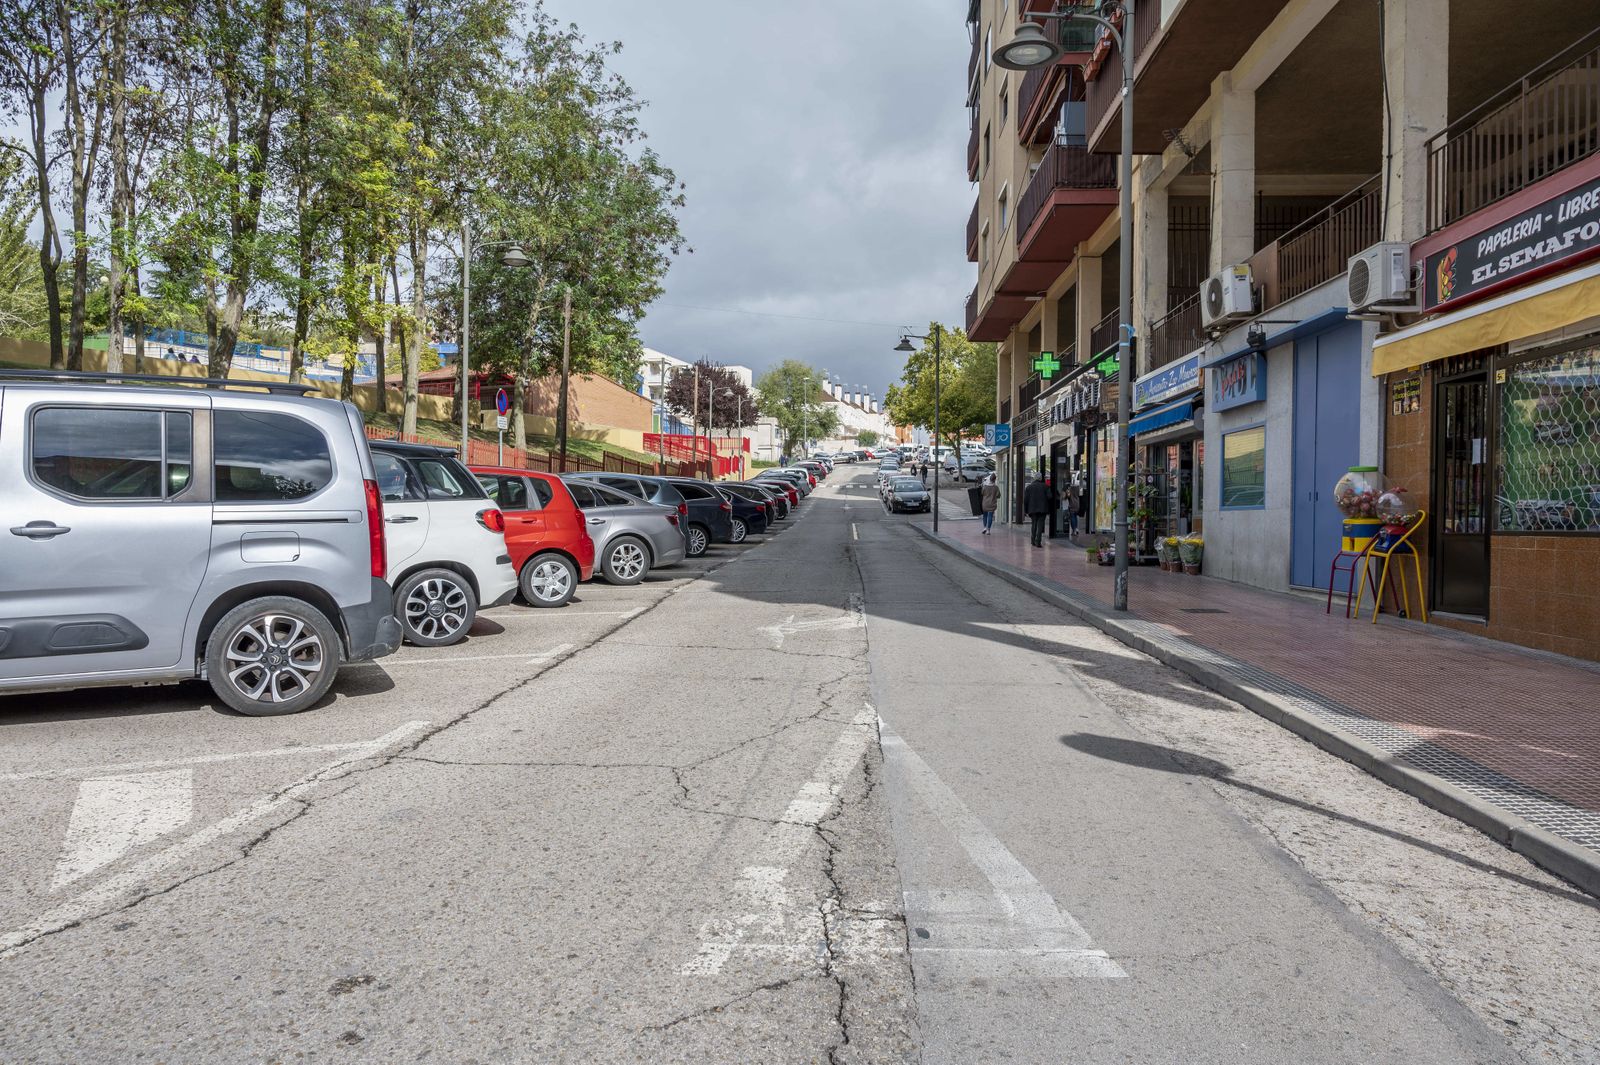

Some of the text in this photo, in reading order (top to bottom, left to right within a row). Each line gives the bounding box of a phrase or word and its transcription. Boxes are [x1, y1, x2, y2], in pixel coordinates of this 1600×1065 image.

[1472, 218, 1600, 284] EL SEMAFO
[1477, 214, 1542, 258] PAPELERIA
